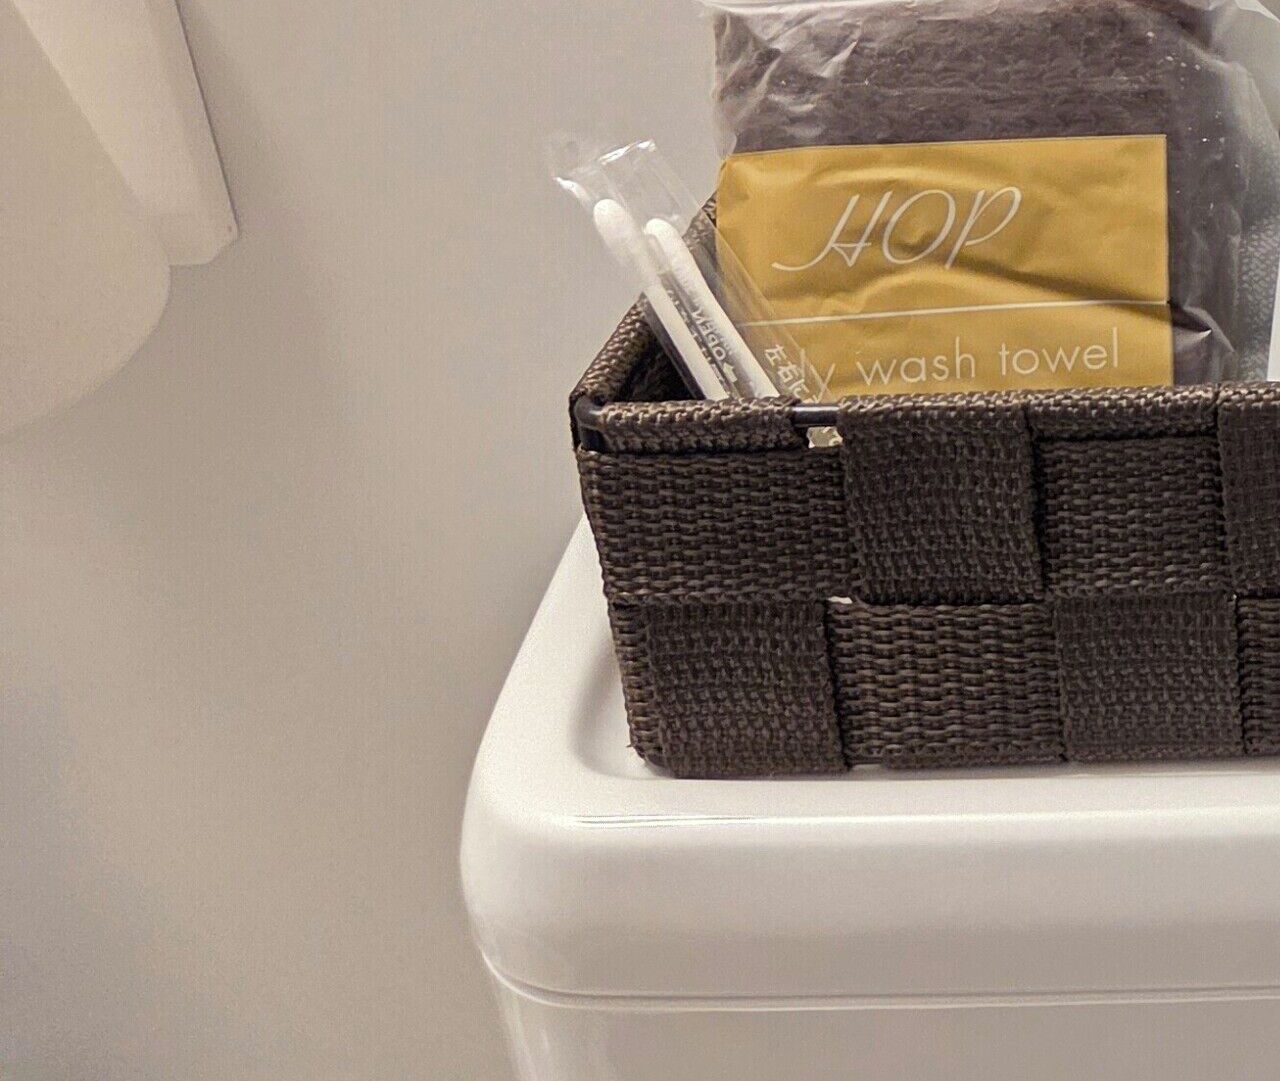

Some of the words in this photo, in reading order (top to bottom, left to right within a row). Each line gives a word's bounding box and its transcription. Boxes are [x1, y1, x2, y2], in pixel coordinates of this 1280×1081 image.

[771, 185, 1022, 271] HOP
[857, 336, 976, 386] wash
[999, 328, 1119, 374] towel
